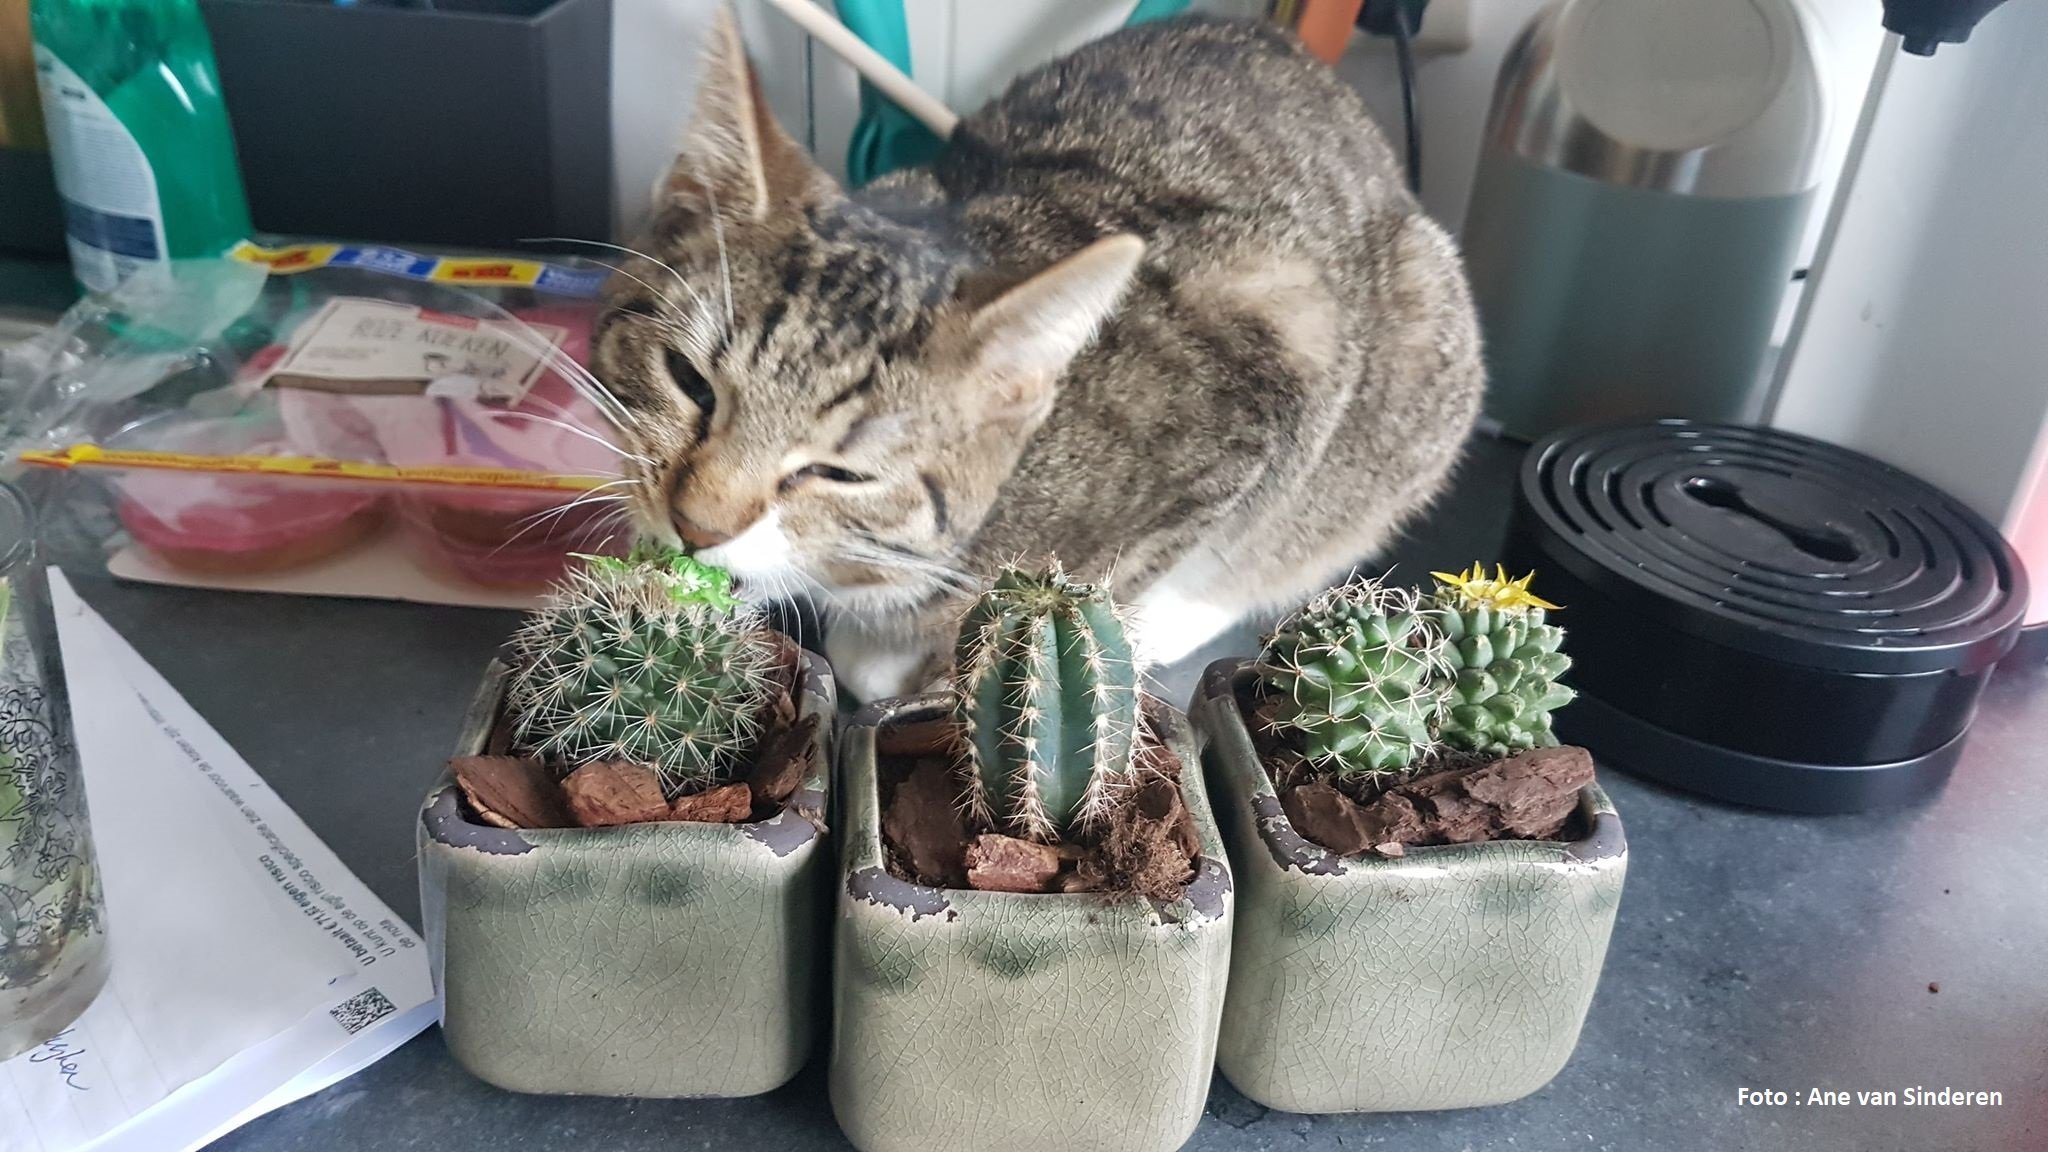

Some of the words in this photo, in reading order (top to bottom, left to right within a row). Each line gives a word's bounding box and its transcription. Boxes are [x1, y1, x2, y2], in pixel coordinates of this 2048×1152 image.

[259, 855, 285, 881] risico
[284, 882, 309, 905] eigen
[363, 930, 386, 947] kunt
